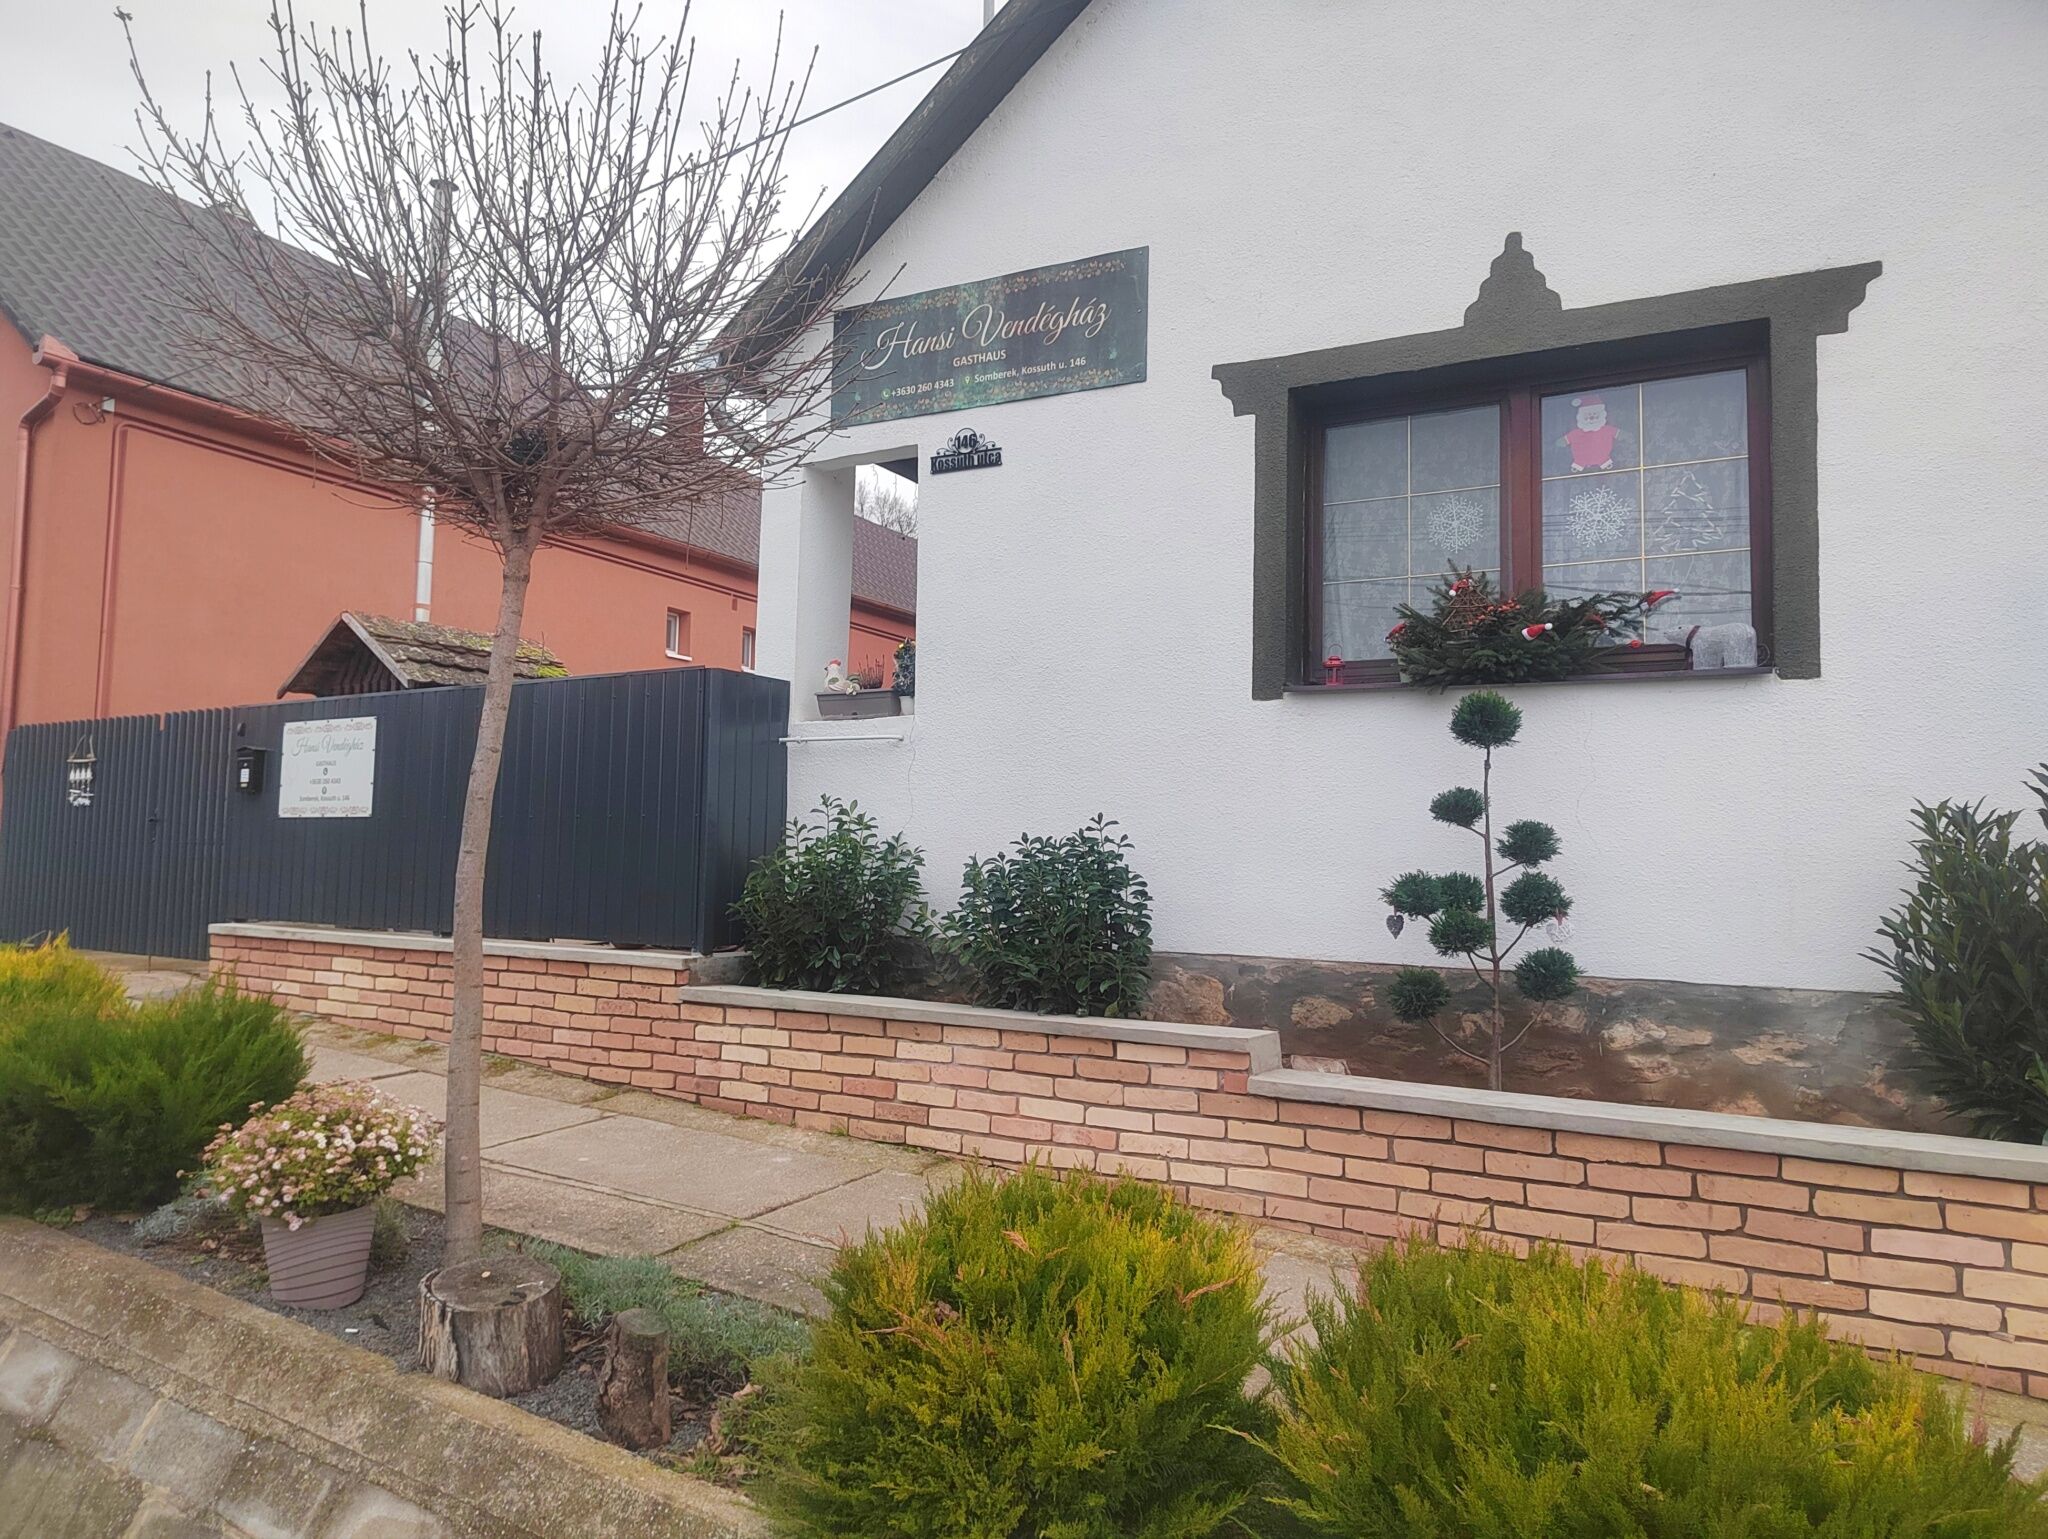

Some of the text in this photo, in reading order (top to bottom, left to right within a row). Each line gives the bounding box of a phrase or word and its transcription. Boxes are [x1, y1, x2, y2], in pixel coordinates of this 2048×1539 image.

[861, 296, 1112, 370] Hansi Vendégház
[953, 349, 1007, 367] GASTHAUS
[974, 356, 1087, 383] Somberek, Kossuth u. 146
[891, 378, 955, 397] +3630 260 4343
[956, 433, 978, 449] 146
